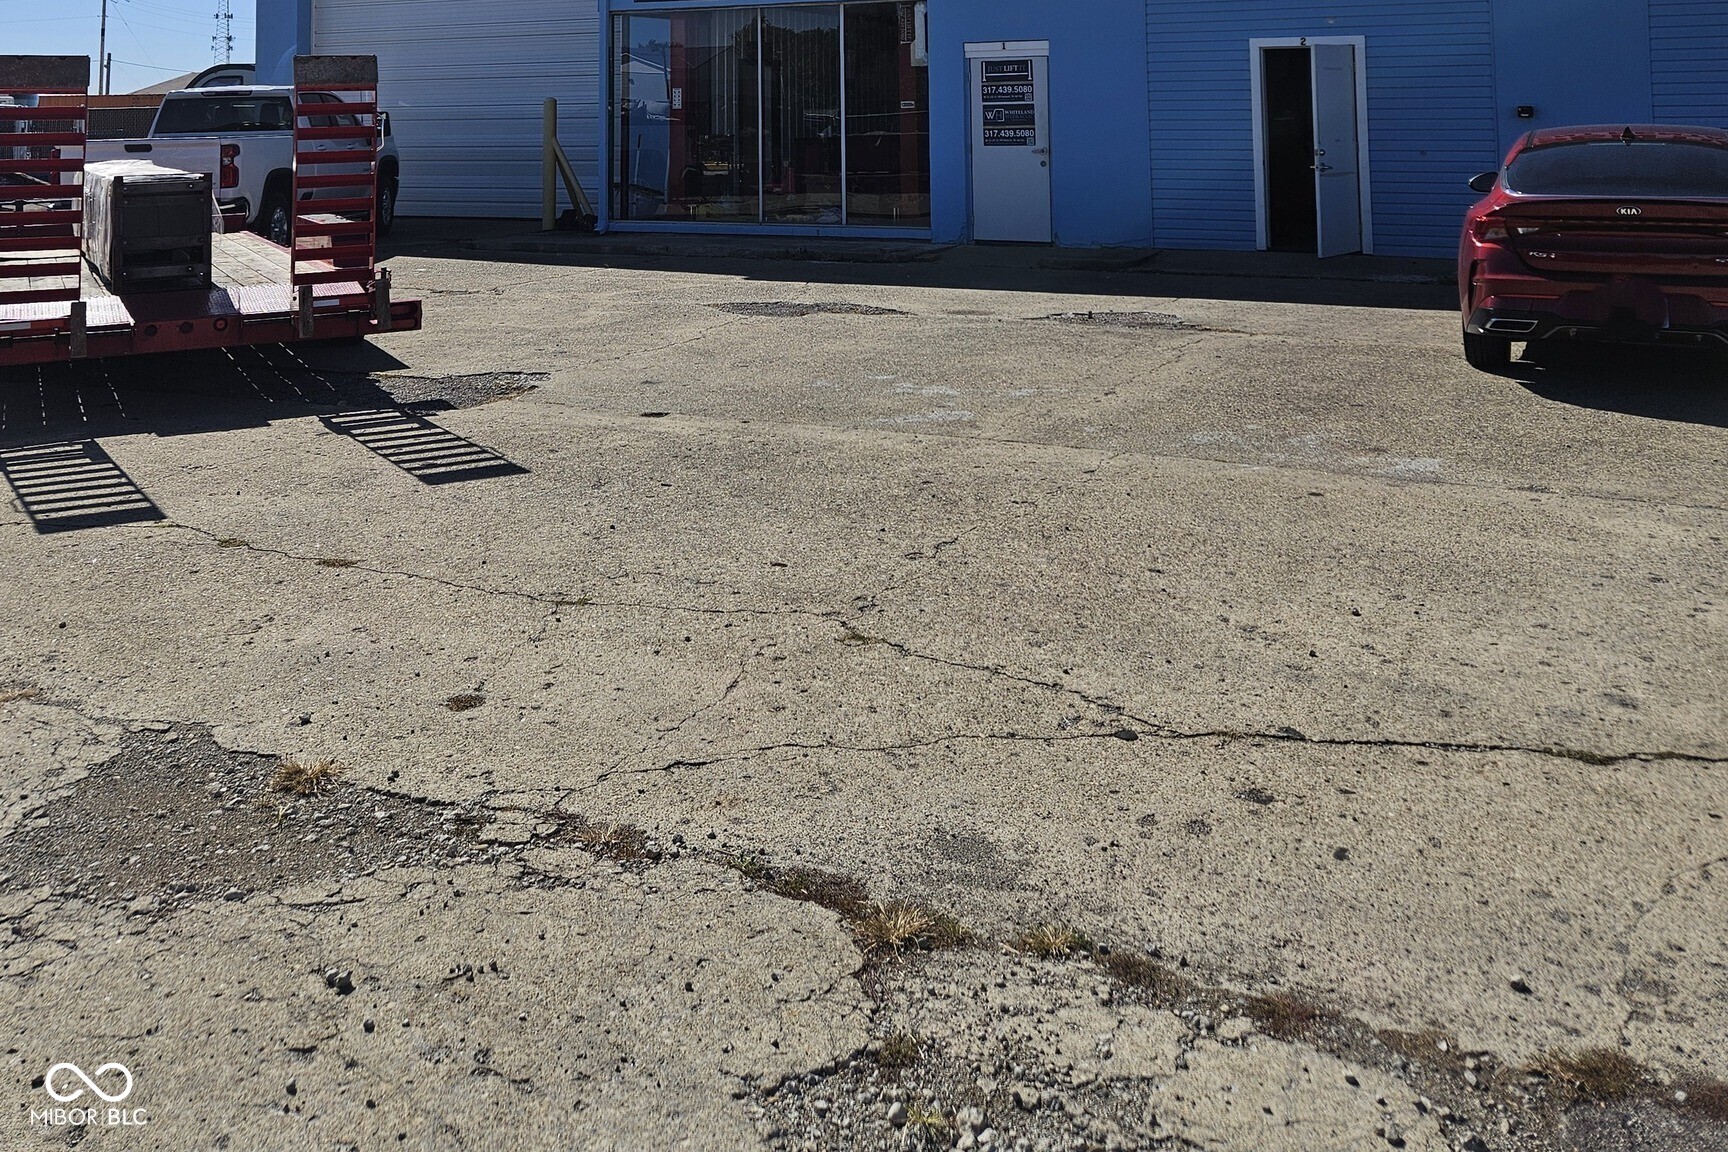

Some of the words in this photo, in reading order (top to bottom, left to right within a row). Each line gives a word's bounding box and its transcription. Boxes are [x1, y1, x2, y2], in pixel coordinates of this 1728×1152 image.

[1301, 37, 1306, 46] 2
[1002, 42, 1006, 50] 1
[983, 86, 1032, 94] 317.439.5080
[985, 130, 1034, 138] 317.439.5080
